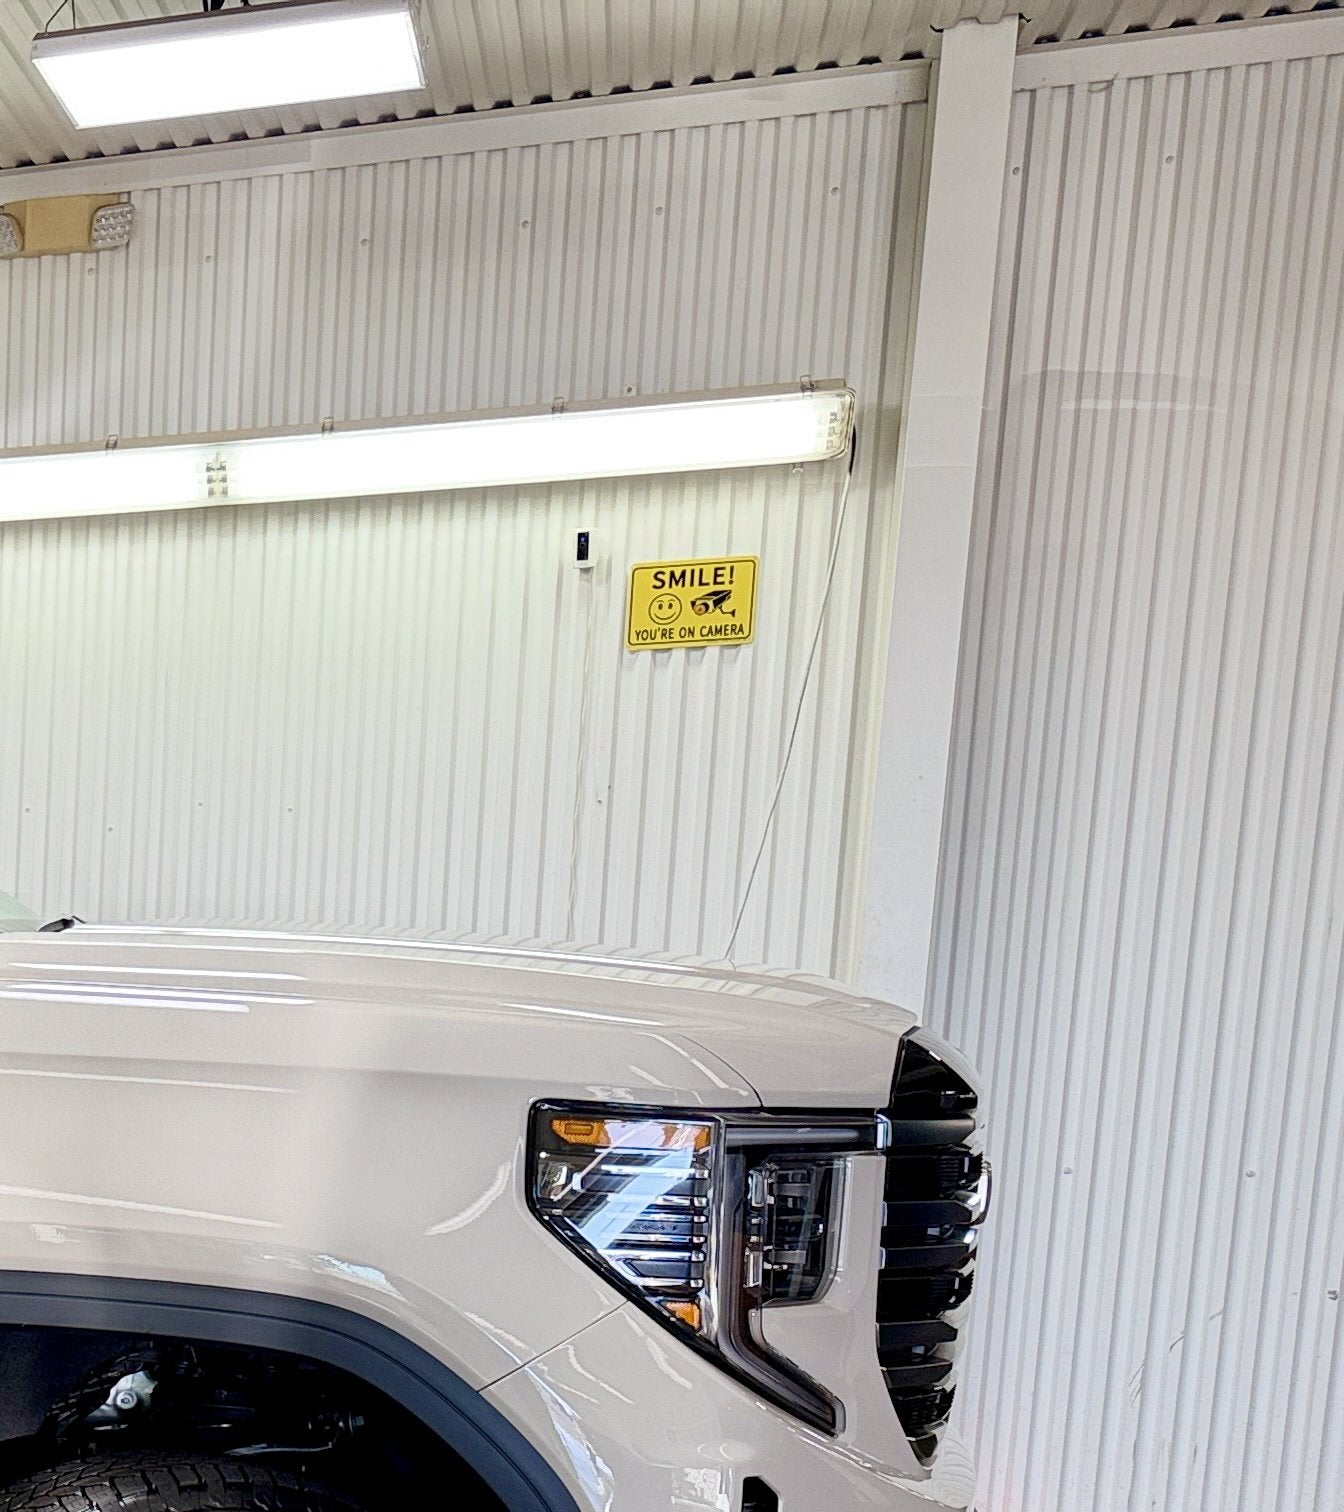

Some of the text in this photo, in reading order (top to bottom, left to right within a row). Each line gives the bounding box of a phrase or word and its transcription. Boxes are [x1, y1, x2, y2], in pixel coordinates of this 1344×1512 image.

[652, 565, 735, 590] SMILE!
[635, 622, 745, 641] YOU'RE ON CAMERA
